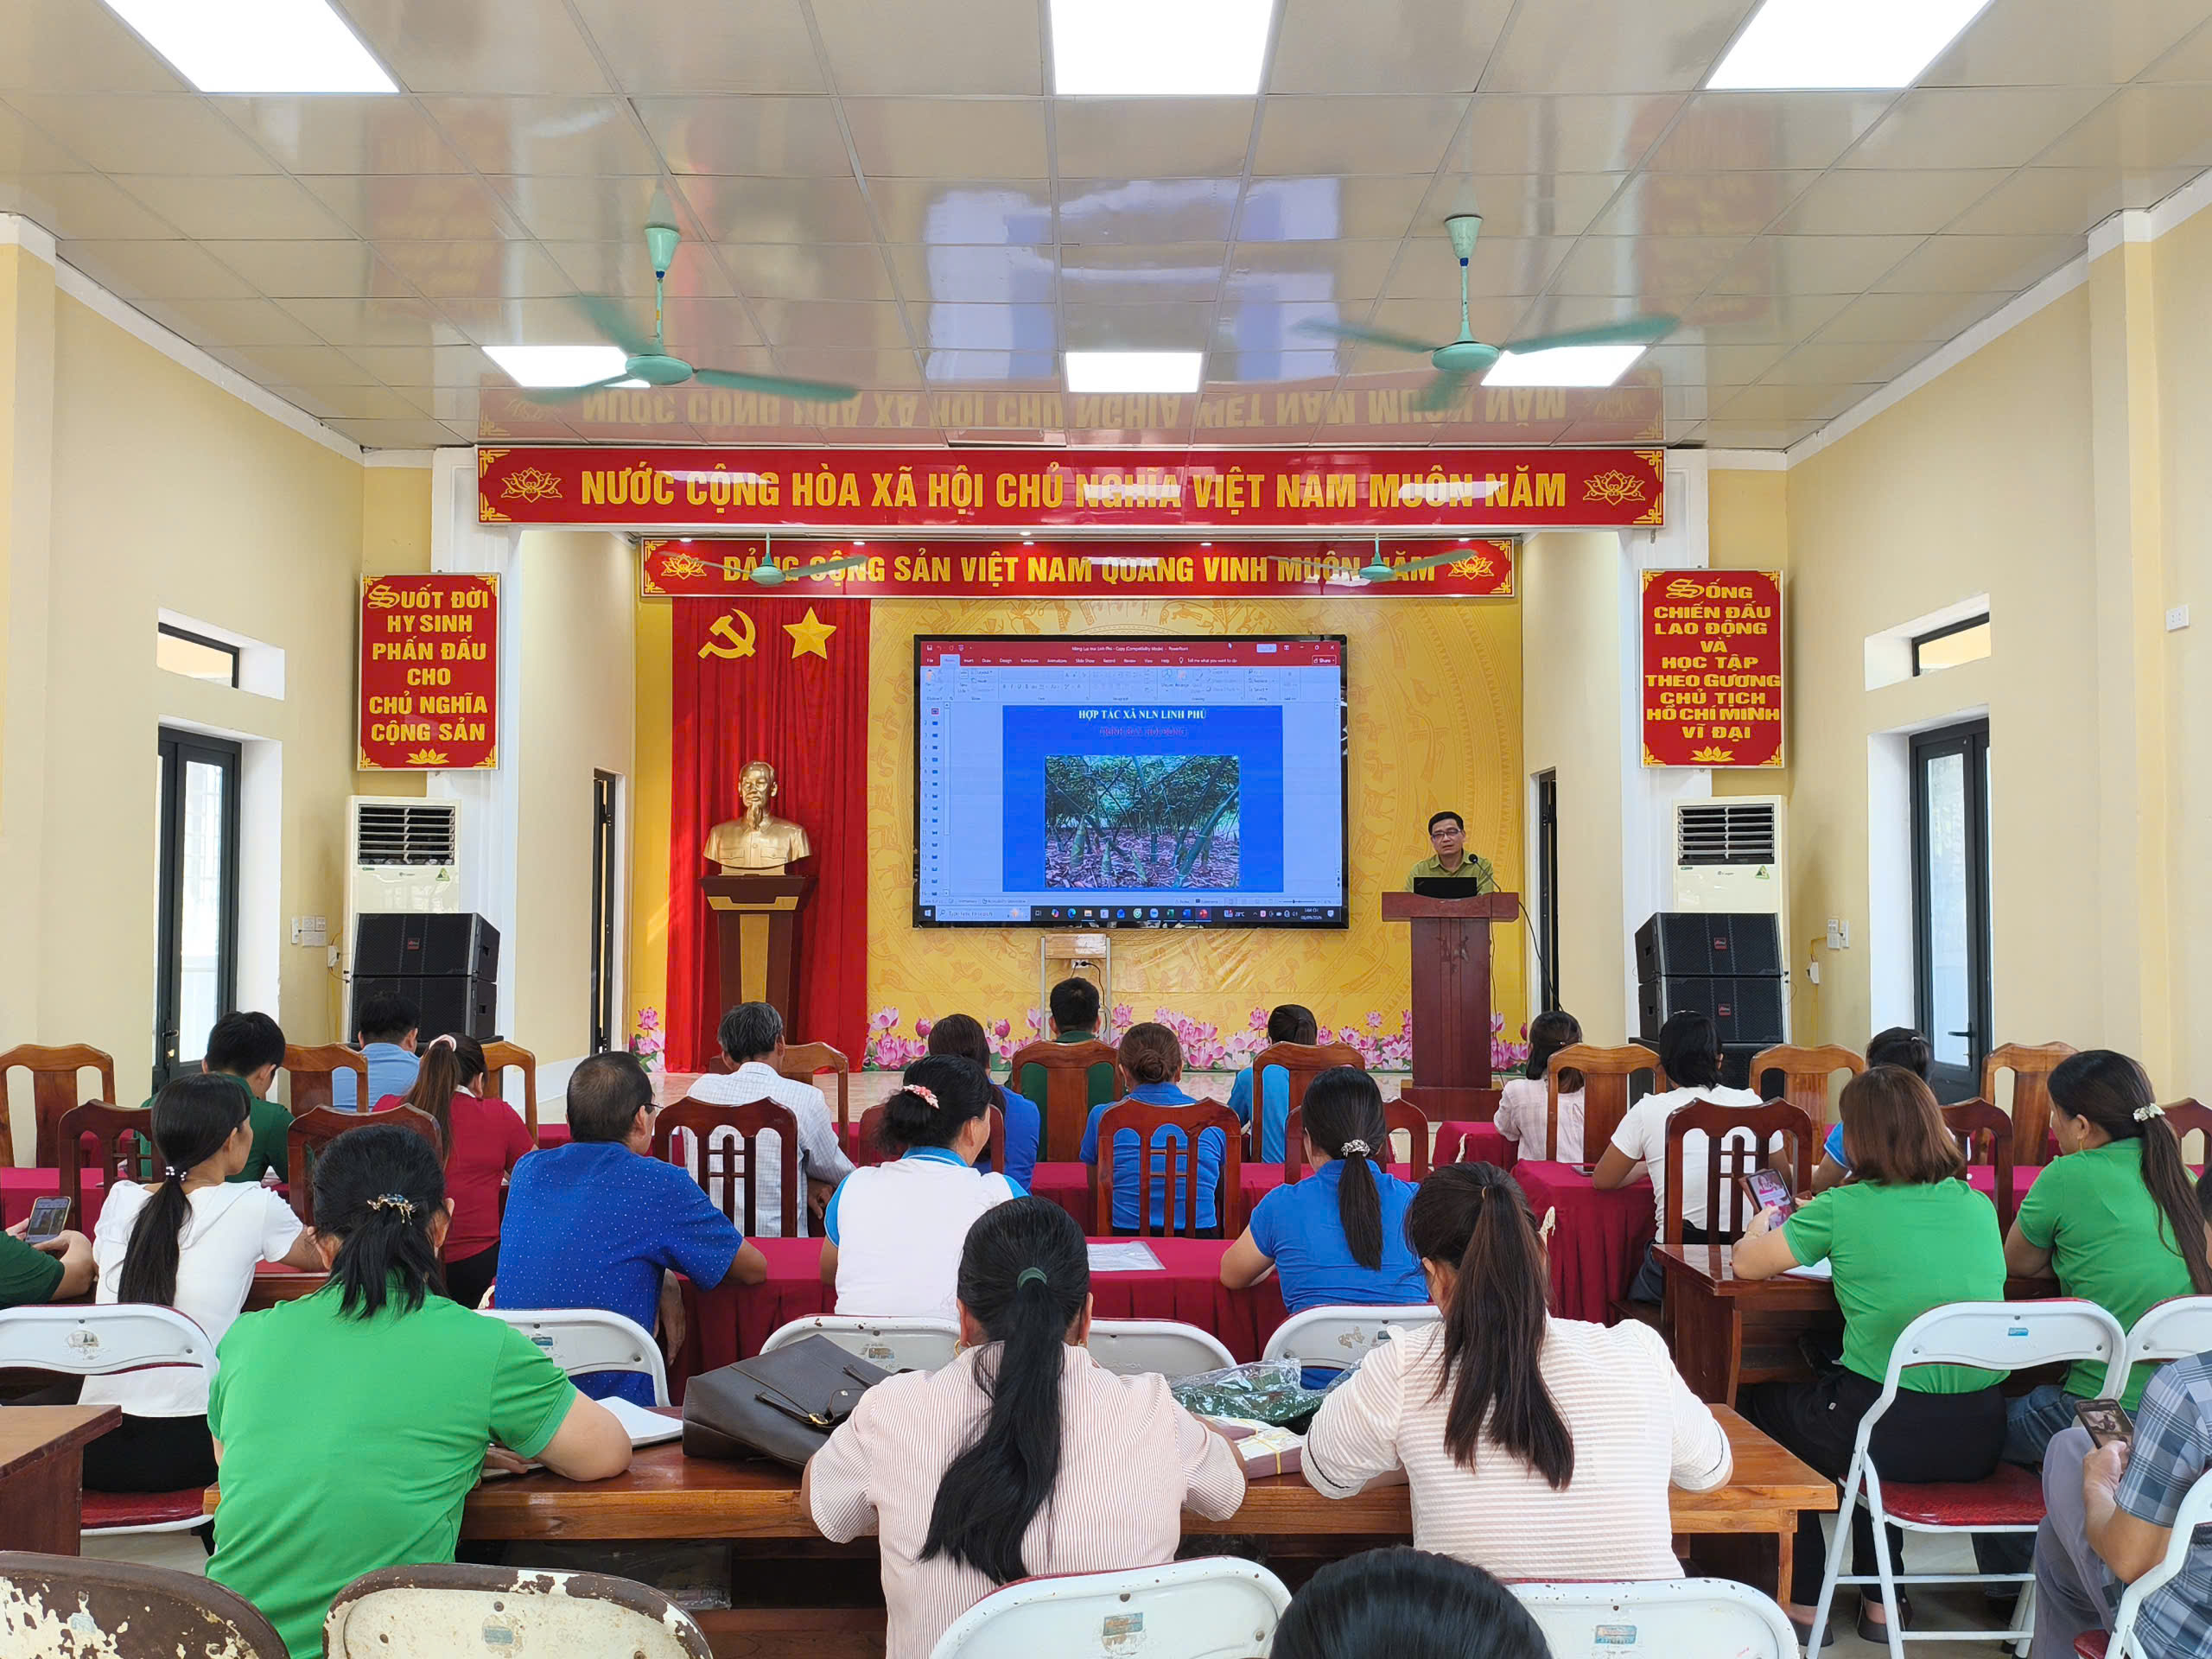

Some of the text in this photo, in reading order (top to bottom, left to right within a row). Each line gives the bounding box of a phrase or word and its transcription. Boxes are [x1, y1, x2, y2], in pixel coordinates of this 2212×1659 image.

[581, 461, 1567, 517] NƯỚC CỘNG HÒA XÃ HỘI CHỦ NGHĨA VIỆT NAM MUÔN NĂM
[723, 547, 799, 582] ĐẢG
[893, 547, 950, 582] SẢN
[960, 550, 1019, 588] VIỆT
[1027, 556, 1092, 582] NAM
[1101, 556, 1194, 583] QUANG
[1203, 556, 1268, 582] VINH
[1277, 550, 1361, 582] MUÔN
[1372, 550, 1435, 582] ĂM
[367, 583, 488, 609] SUỐT ĐỜI
[1666, 577, 1753, 599] SỐNG
[1654, 601, 1771, 620] CHIẾN ĐẤU
[387, 614, 473, 632] HY SINH
[1654, 619, 1768, 638] LAO ĐỘNG
[372, 636, 486, 660] PHẤN ĐẤU
[1700, 637, 1728, 653] VÀ
[1662, 653, 1759, 672] HỌC TẬP
[407, 668, 451, 686] CHO
[1645, 674, 1782, 688] THEO GƯƠNG
[369, 690, 488, 715] CHỦ NGHĨA
[1660, 689, 1766, 708] CHỦ TỊCH
[1078, 709, 1099, 721] HỢP
[1102, 708, 1121, 719] TÁC
[1139, 709, 1159, 719] NLN
[1160, 709, 1185, 719] LINH
[1187, 708, 1207, 719] PHÚ
[1679, 705, 1716, 721] CHÍ
[1719, 708, 1780, 721] MINH
[371, 717, 486, 746] CỘNG SẢN
[1681, 723, 1751, 742] VĨ ĐẠI
